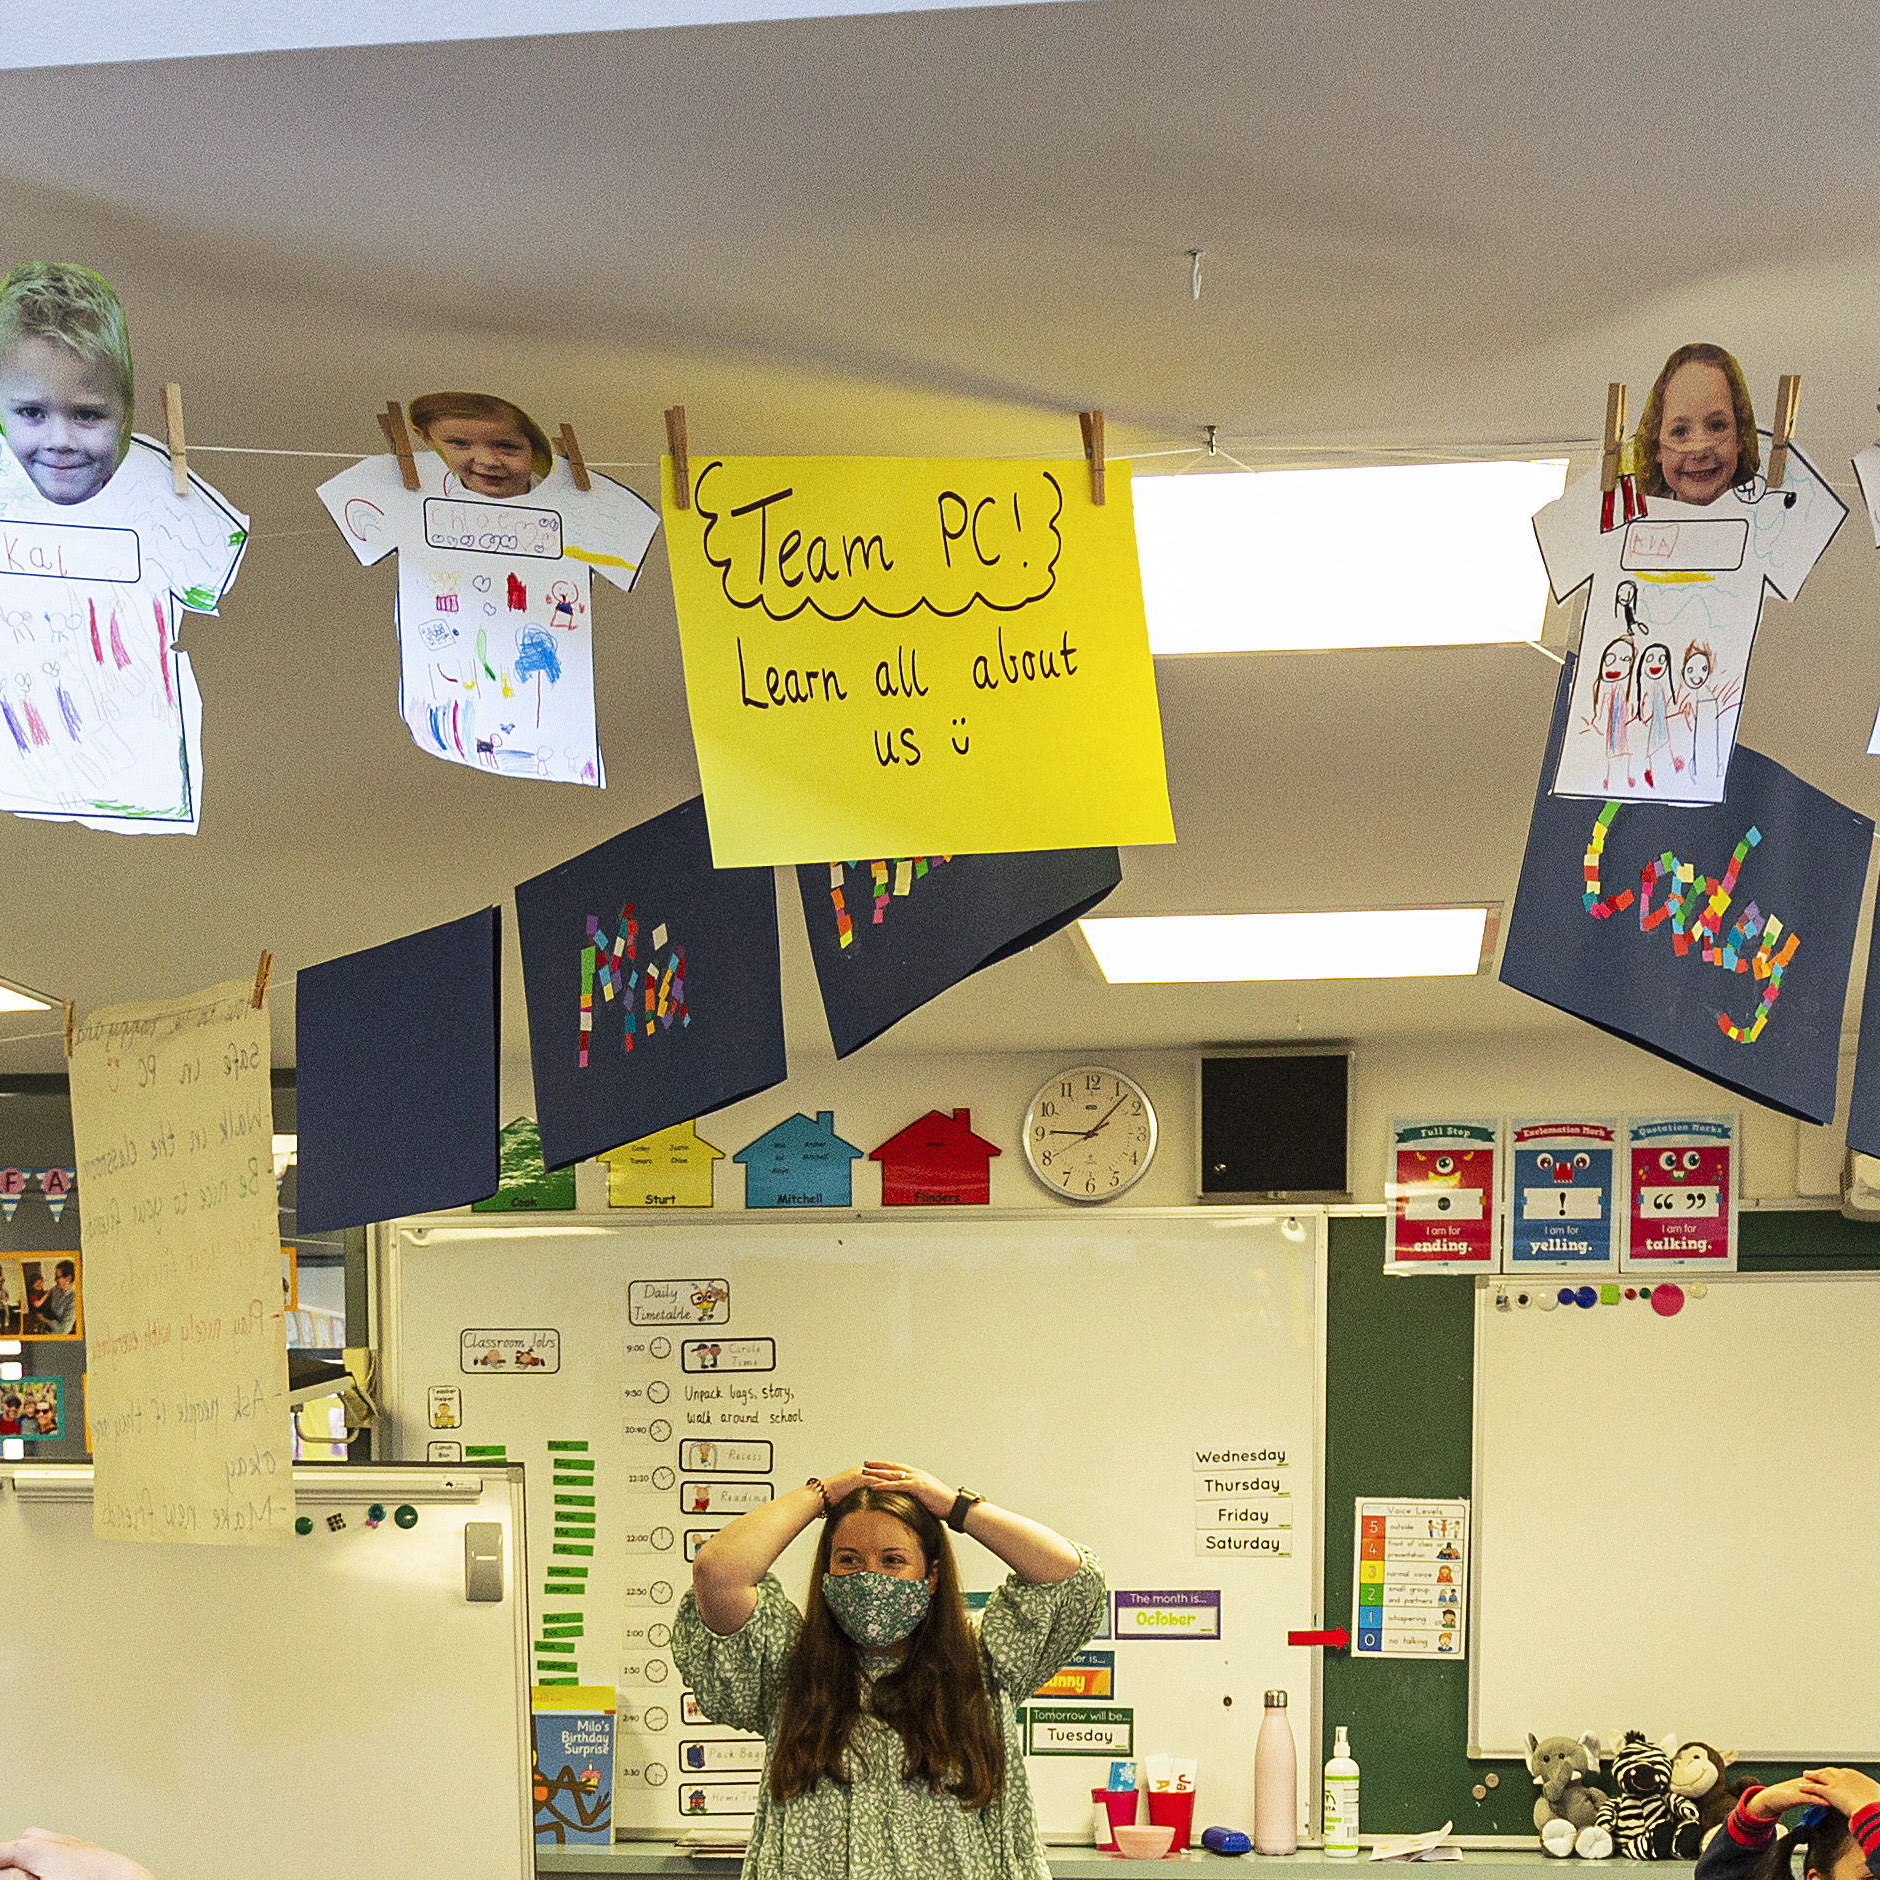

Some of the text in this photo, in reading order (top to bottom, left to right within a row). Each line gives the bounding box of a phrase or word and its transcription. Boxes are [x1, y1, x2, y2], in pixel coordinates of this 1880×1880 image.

[731, 488, 1029, 589] Team PC!
[736, 627, 1079, 710] Learn all about
[873, 727, 920, 767] us
[1061, 1082, 1072, 1098] 11
[1086, 1075, 1101, 1090] 12
[1116, 1082, 1120, 1097] 1
[1041, 1102, 1055, 1117] 10
[1131, 1101, 1142, 1117] 2
[1035, 1126, 1045, 1141] 9
[1137, 1126, 1147, 1142] 3
[1421, 1126, 1471, 1138] Full Stop
[1523, 1125, 1605, 1138] Exclamation Mark
[1639, 1123, 1722, 1135] Quotation Marks
[1042, 1150, 1052, 1166] 8
[1129, 1150, 1137, 1165] 4
[1062, 1171, 1071, 1187] 7
[1085, 1177, 1096, 1193] 6
[1109, 1171, 1120, 1187] 5
[645, 1194, 676, 1206] Sturt
[778, 1193, 823, 1205] Mitchell
[1447, 1225, 1461, 1235] for
[1565, 1225, 1579, 1235] for
[1667, 1226, 1681, 1234] am
[1683, 1223, 1697, 1234] for
[1414, 1237, 1472, 1254] ending.
[1530, 1237, 1592, 1255] yelling.
[1645, 1236, 1712, 1252] talking.
[644, 1284, 679, 1303] Daily
[634, 1306, 691, 1321] Timetable
[464, 1332, 525, 1349] Classroom
[684, 1385, 721, 1402] Unpack
[687, 1408, 804, 1424] walk around school
[1196, 1448, 1286, 1463] Wednesday
[1204, 1477, 1280, 1493] Thursday
[1218, 1508, 1269, 1525] Friday
[1387, 1506, 1443, 1515] Voice Levels
[1369, 1520, 1378, 1533] 5
[1206, 1535, 1280, 1553] Saturday
[1369, 1544, 1377, 1555] 4
[1368, 1565, 1376, 1578] 3
[1130, 1593, 1149, 1604] The
[1152, 1593, 1188, 1604] month
[1368, 1588, 1375, 1601] 2
[1136, 1611, 1196, 1628] October
[1368, 1611, 1373, 1623] 1
[1364, 1633, 1375, 1646] 0
[1033, 1710, 1086, 1721] Tomorrow
[1090, 1710, 1107, 1721] will
[577, 1720, 609, 1733] Milo's
[561, 1731, 609, 1745] Birthday
[1047, 1727, 1114, 1746] Tuesday
[564, 1743, 609, 1758] Surprise
